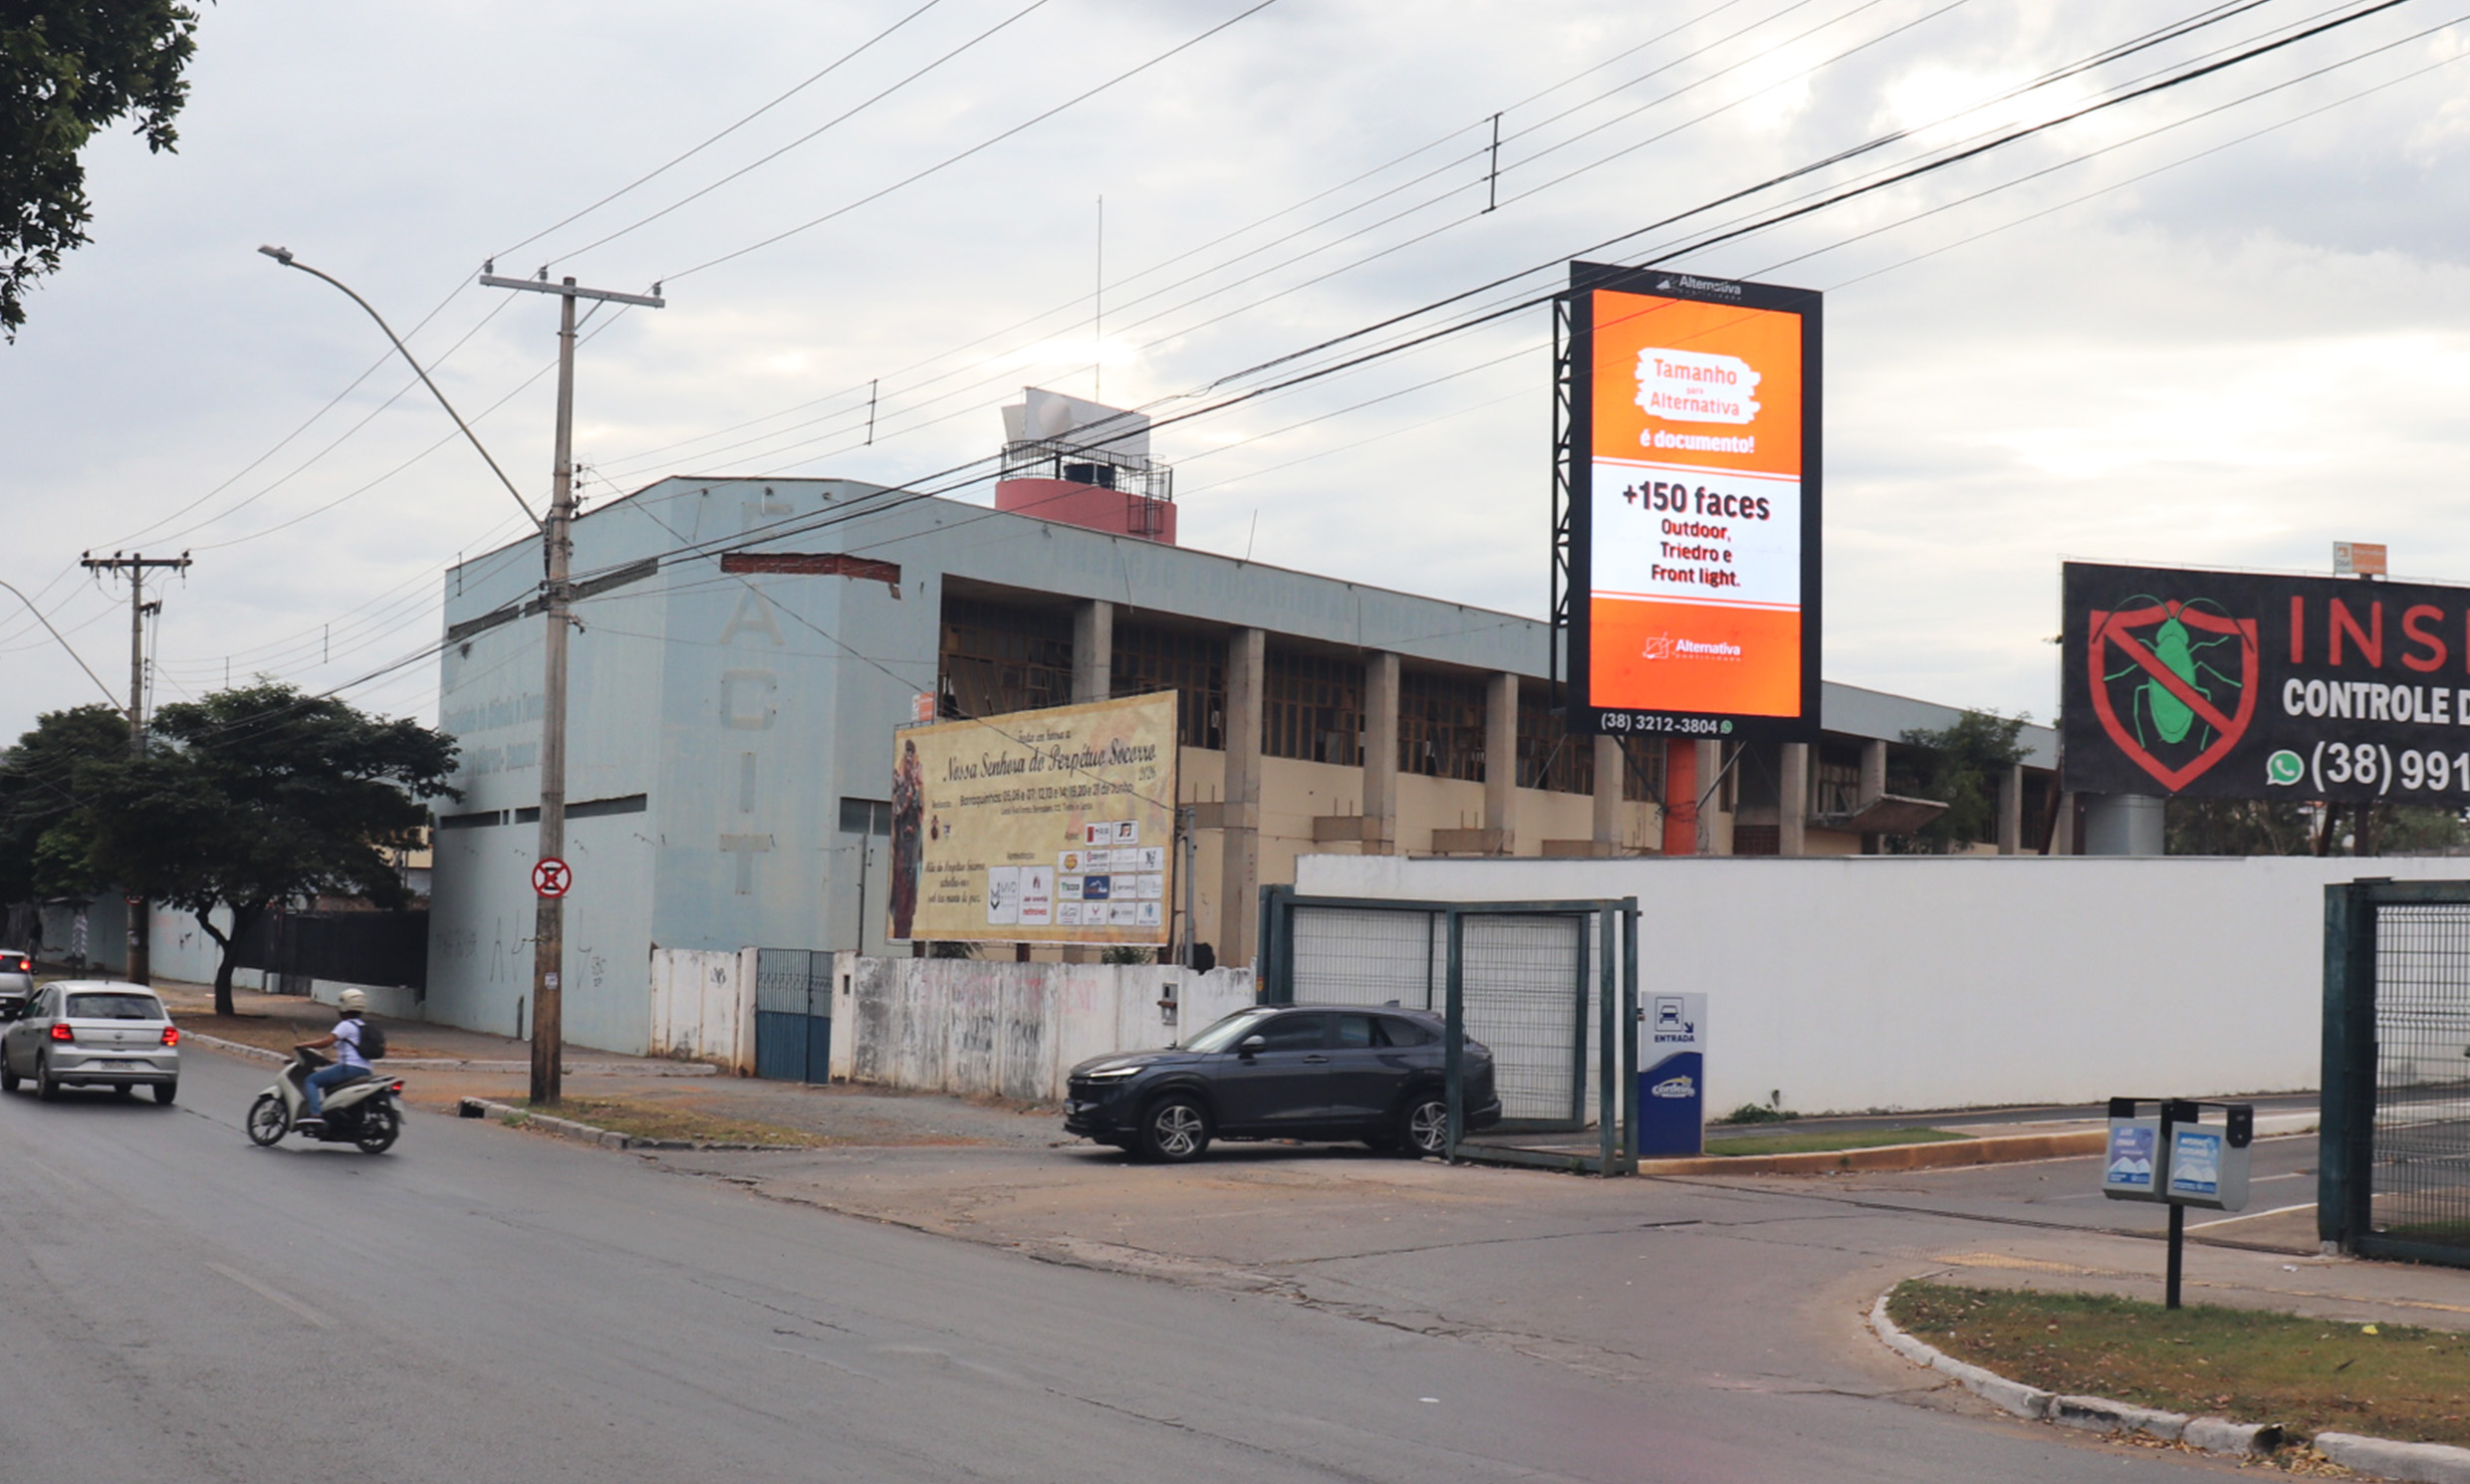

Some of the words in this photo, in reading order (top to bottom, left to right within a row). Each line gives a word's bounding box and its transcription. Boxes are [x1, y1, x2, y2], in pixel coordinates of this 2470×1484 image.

[1678, 274, 1742, 296] Alternativa
[1653, 358, 1738, 385] Tamanho
[1650, 391, 1740, 416] Alternativa
[1639, 428, 1651, 447] é
[1653, 429, 1755, 454] documento!
[1622, 480, 1687, 513] +150
[1695, 486, 1771, 521] faces
[1661, 518, 1731, 542] Outdoor,
[1660, 541, 1720, 563] Triedro
[1723, 549, 1733, 564] e
[1651, 564, 1695, 584] Front
[1699, 568, 1741, 589] light.
[1675, 637, 1742, 656] Alternativa
[2290, 595, 2470, 675] INS
[2283, 678, 2451, 725] CONTROLE
[1602, 712, 1631, 732] (38)
[1635, 715, 1718, 734] 3212-3804
[943, 755, 978, 782] Nossa
[980, 749, 1027, 778] Senhora
[1029, 746, 1046, 772] do
[1048, 743, 1107, 778] Perpétuo
[1109, 737, 1156, 766] Socorro
[2312, 740, 2392, 796] (38)
[2399, 749, 2470, 792] 991
[1654, 1034, 1695, 1043] ENTRADA
